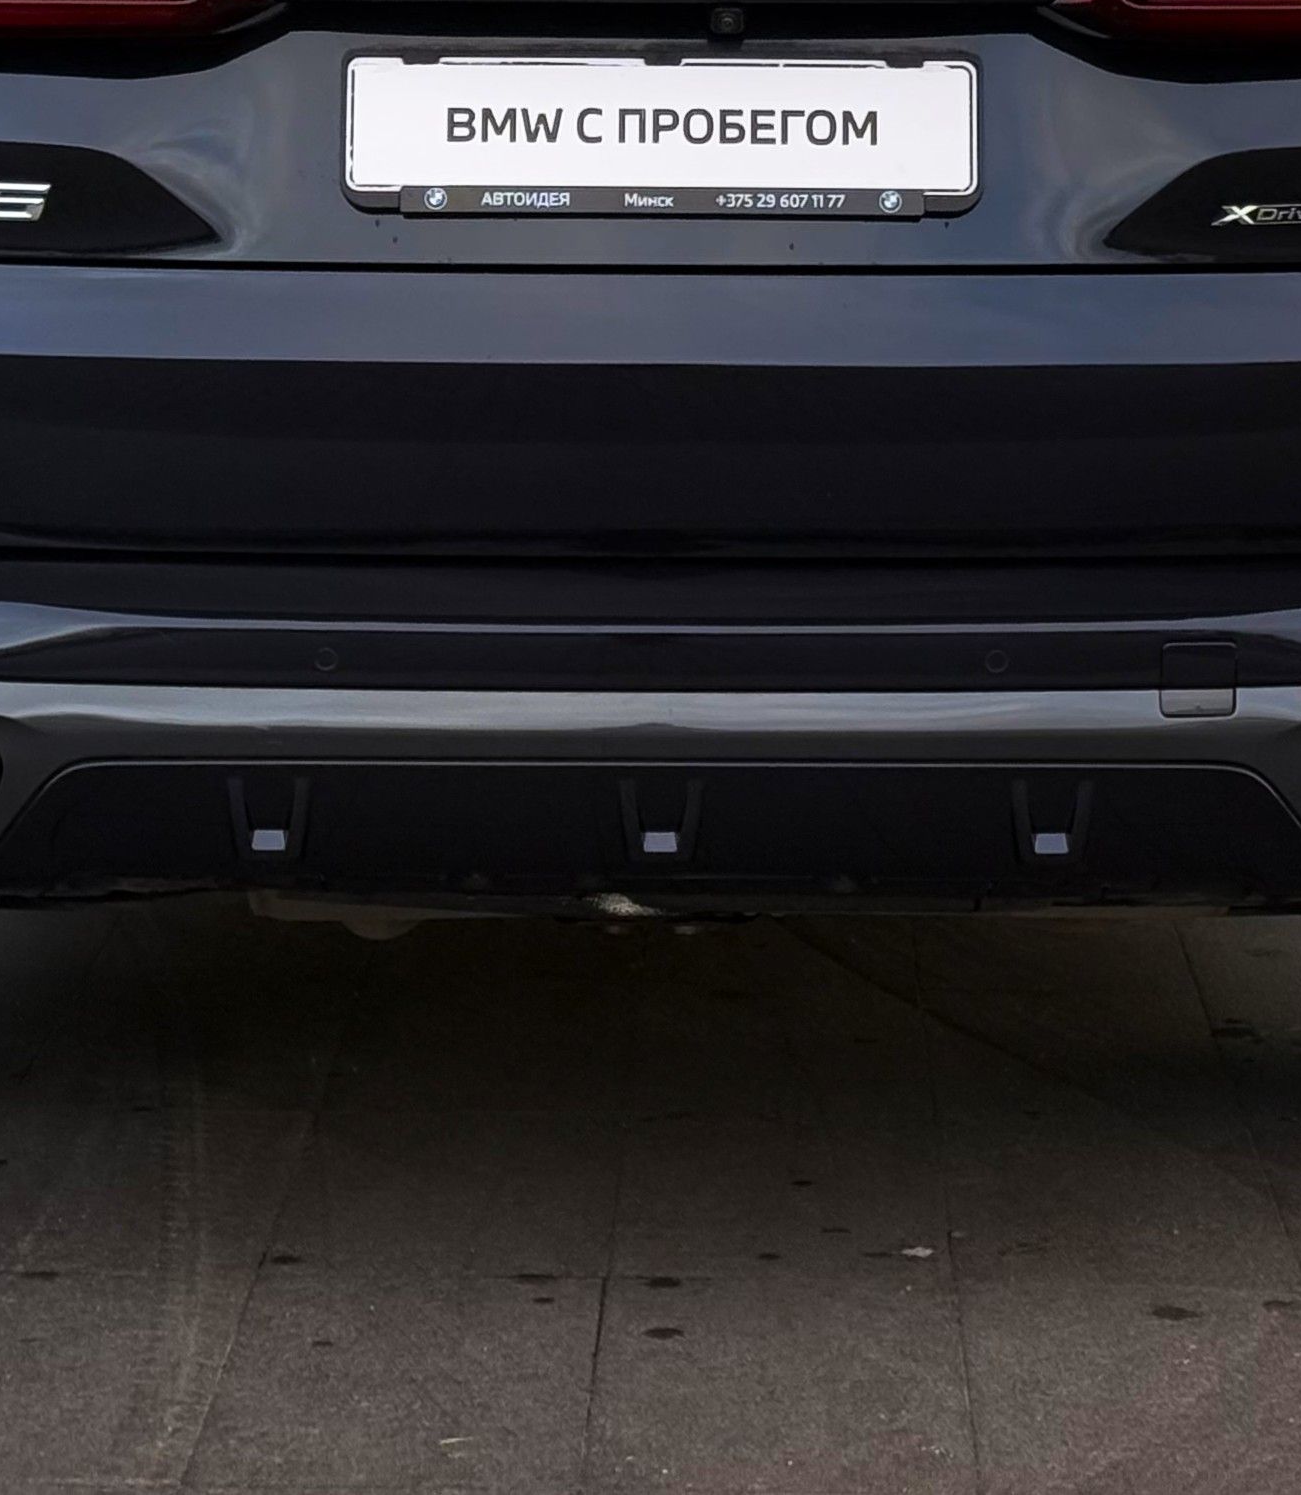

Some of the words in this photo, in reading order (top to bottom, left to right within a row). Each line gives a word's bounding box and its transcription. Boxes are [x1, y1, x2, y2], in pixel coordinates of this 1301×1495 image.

[446, 107, 563, 143] BMW
[576, 107, 603, 144] С
[618, 108, 879, 146] ПРОБЕГОМ
[481, 191, 571, 209] АВТОИДЕЯ
[624, 192, 674, 208] Минск
[715, 193, 754, 208] +375
[756, 193, 776, 208] 29
[779, 194, 809, 208] 607
[811, 194, 825, 208] 11
[826, 194, 846, 208] 77
